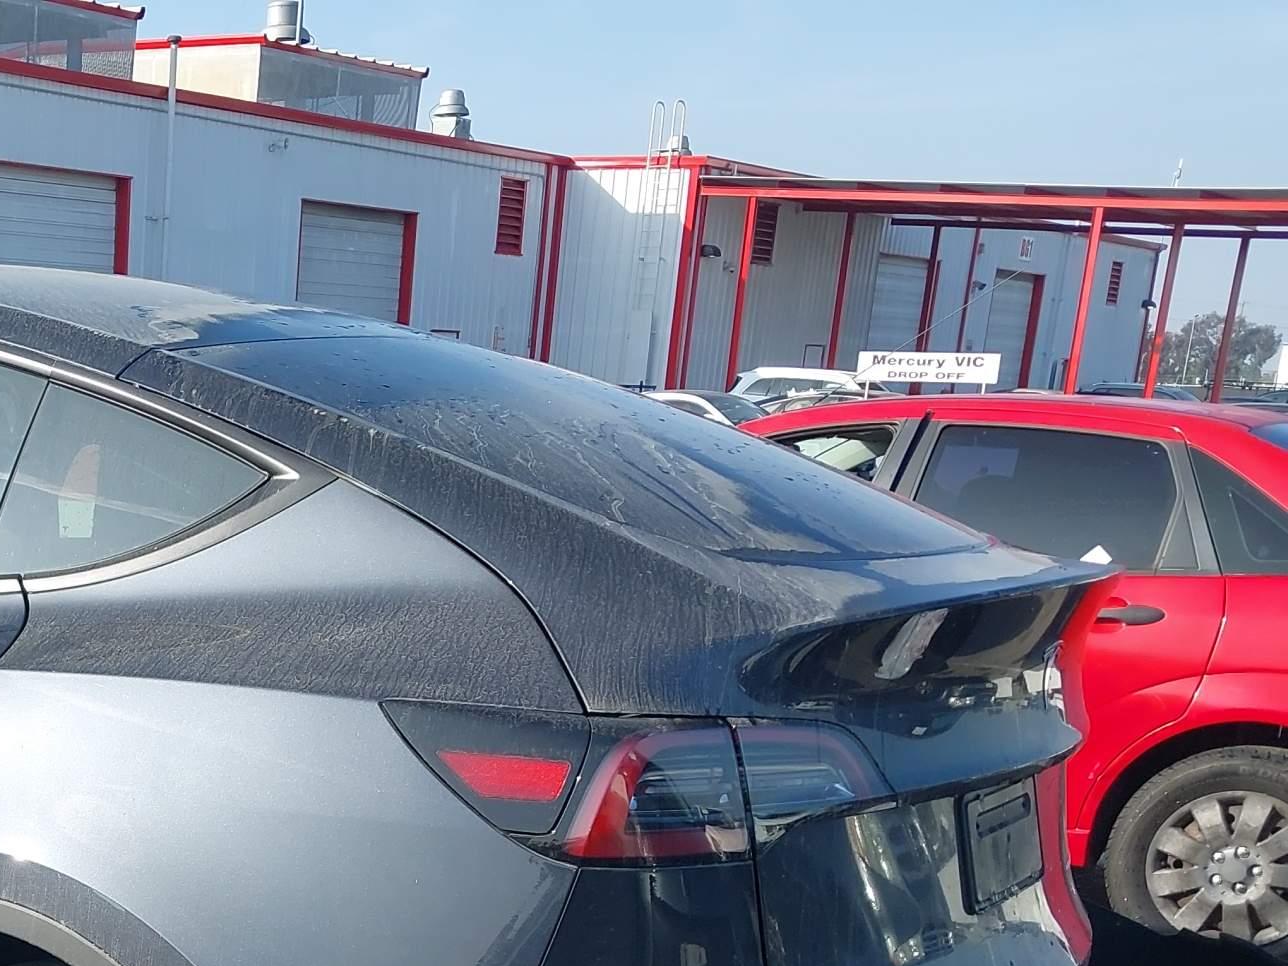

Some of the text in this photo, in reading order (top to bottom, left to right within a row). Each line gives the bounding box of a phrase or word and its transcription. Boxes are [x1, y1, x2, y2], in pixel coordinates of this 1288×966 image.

[872, 354, 985, 368] Mercury VIC
[887, 370, 966, 380] DROP OFF
